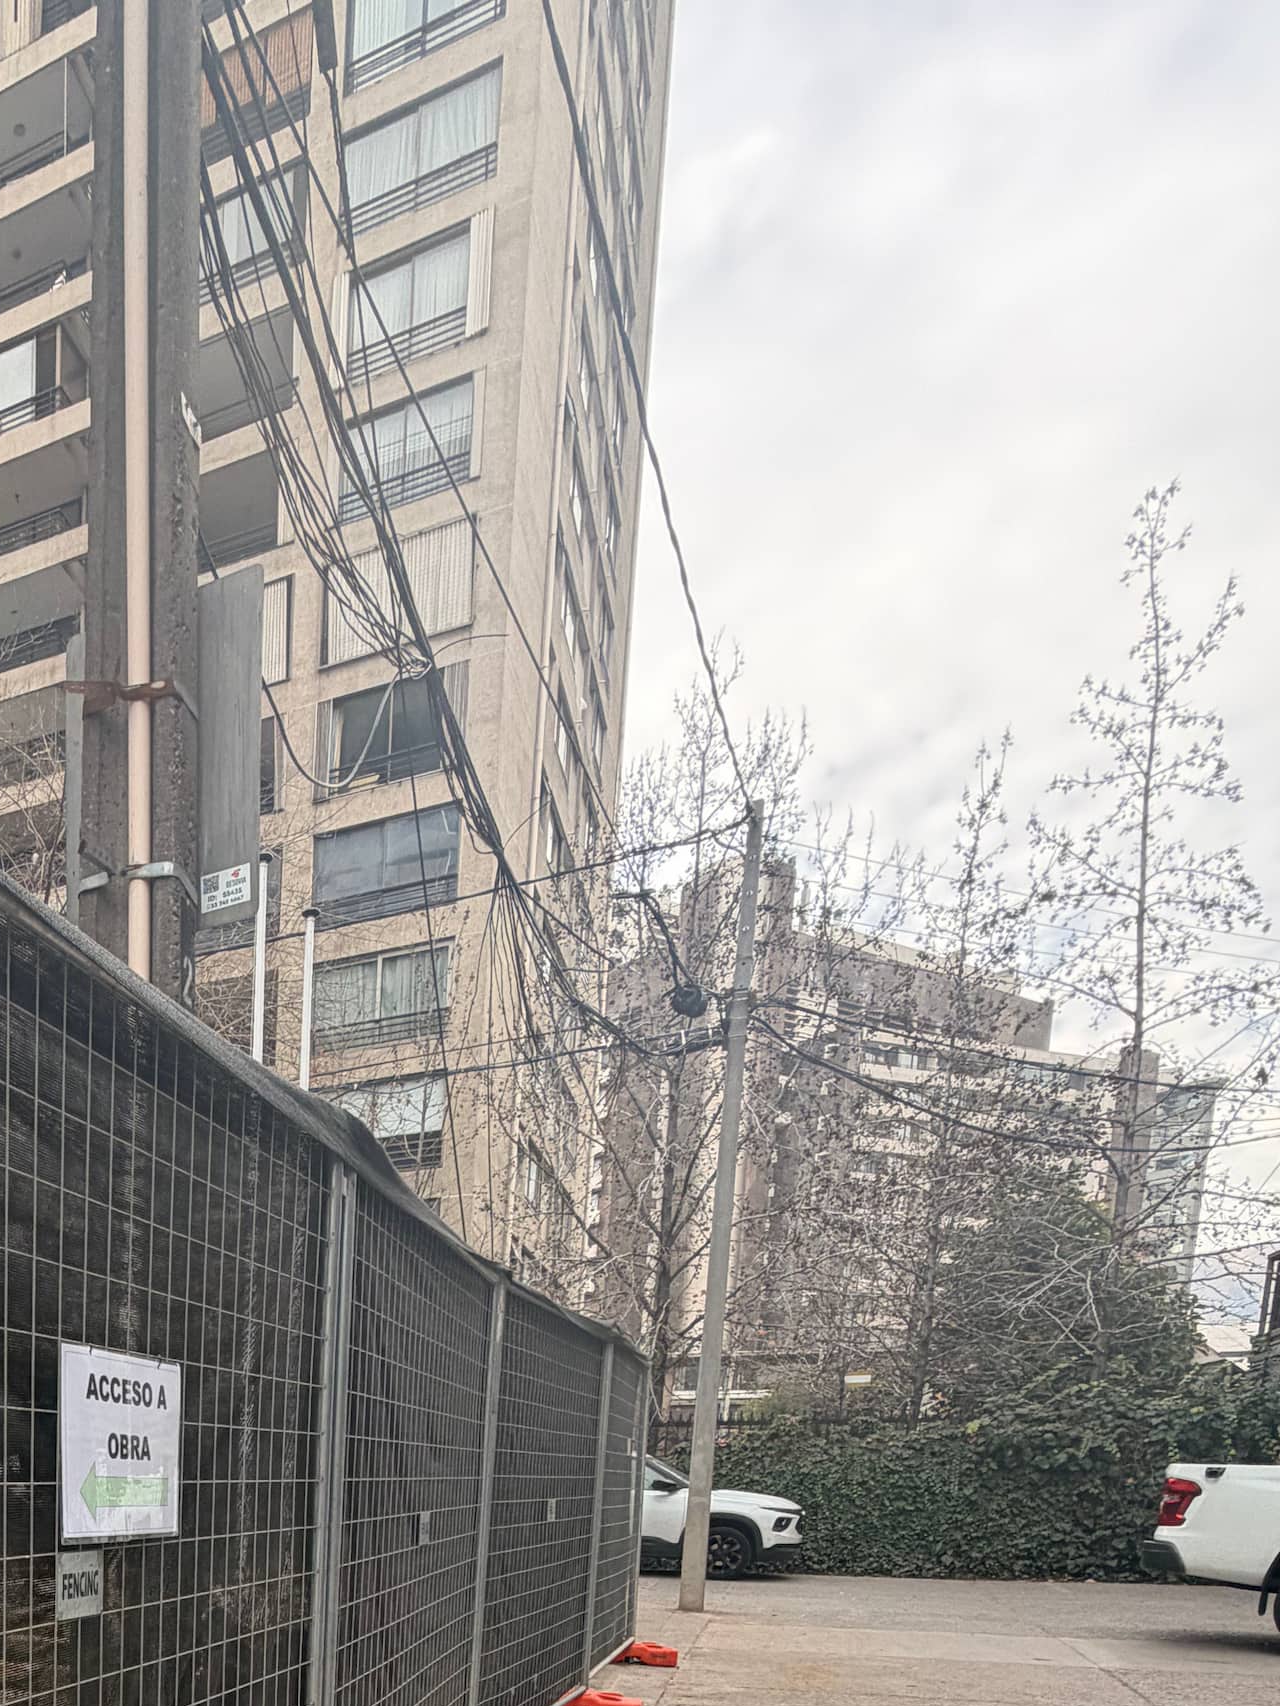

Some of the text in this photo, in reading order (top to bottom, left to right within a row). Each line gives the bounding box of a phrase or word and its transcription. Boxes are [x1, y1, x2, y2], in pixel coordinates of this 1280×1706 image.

[86, 1373, 167, 1410] ACCESO A
[107, 1433, 151, 1461] OBRA
[61, 1570, 99, 1600] FENCING
